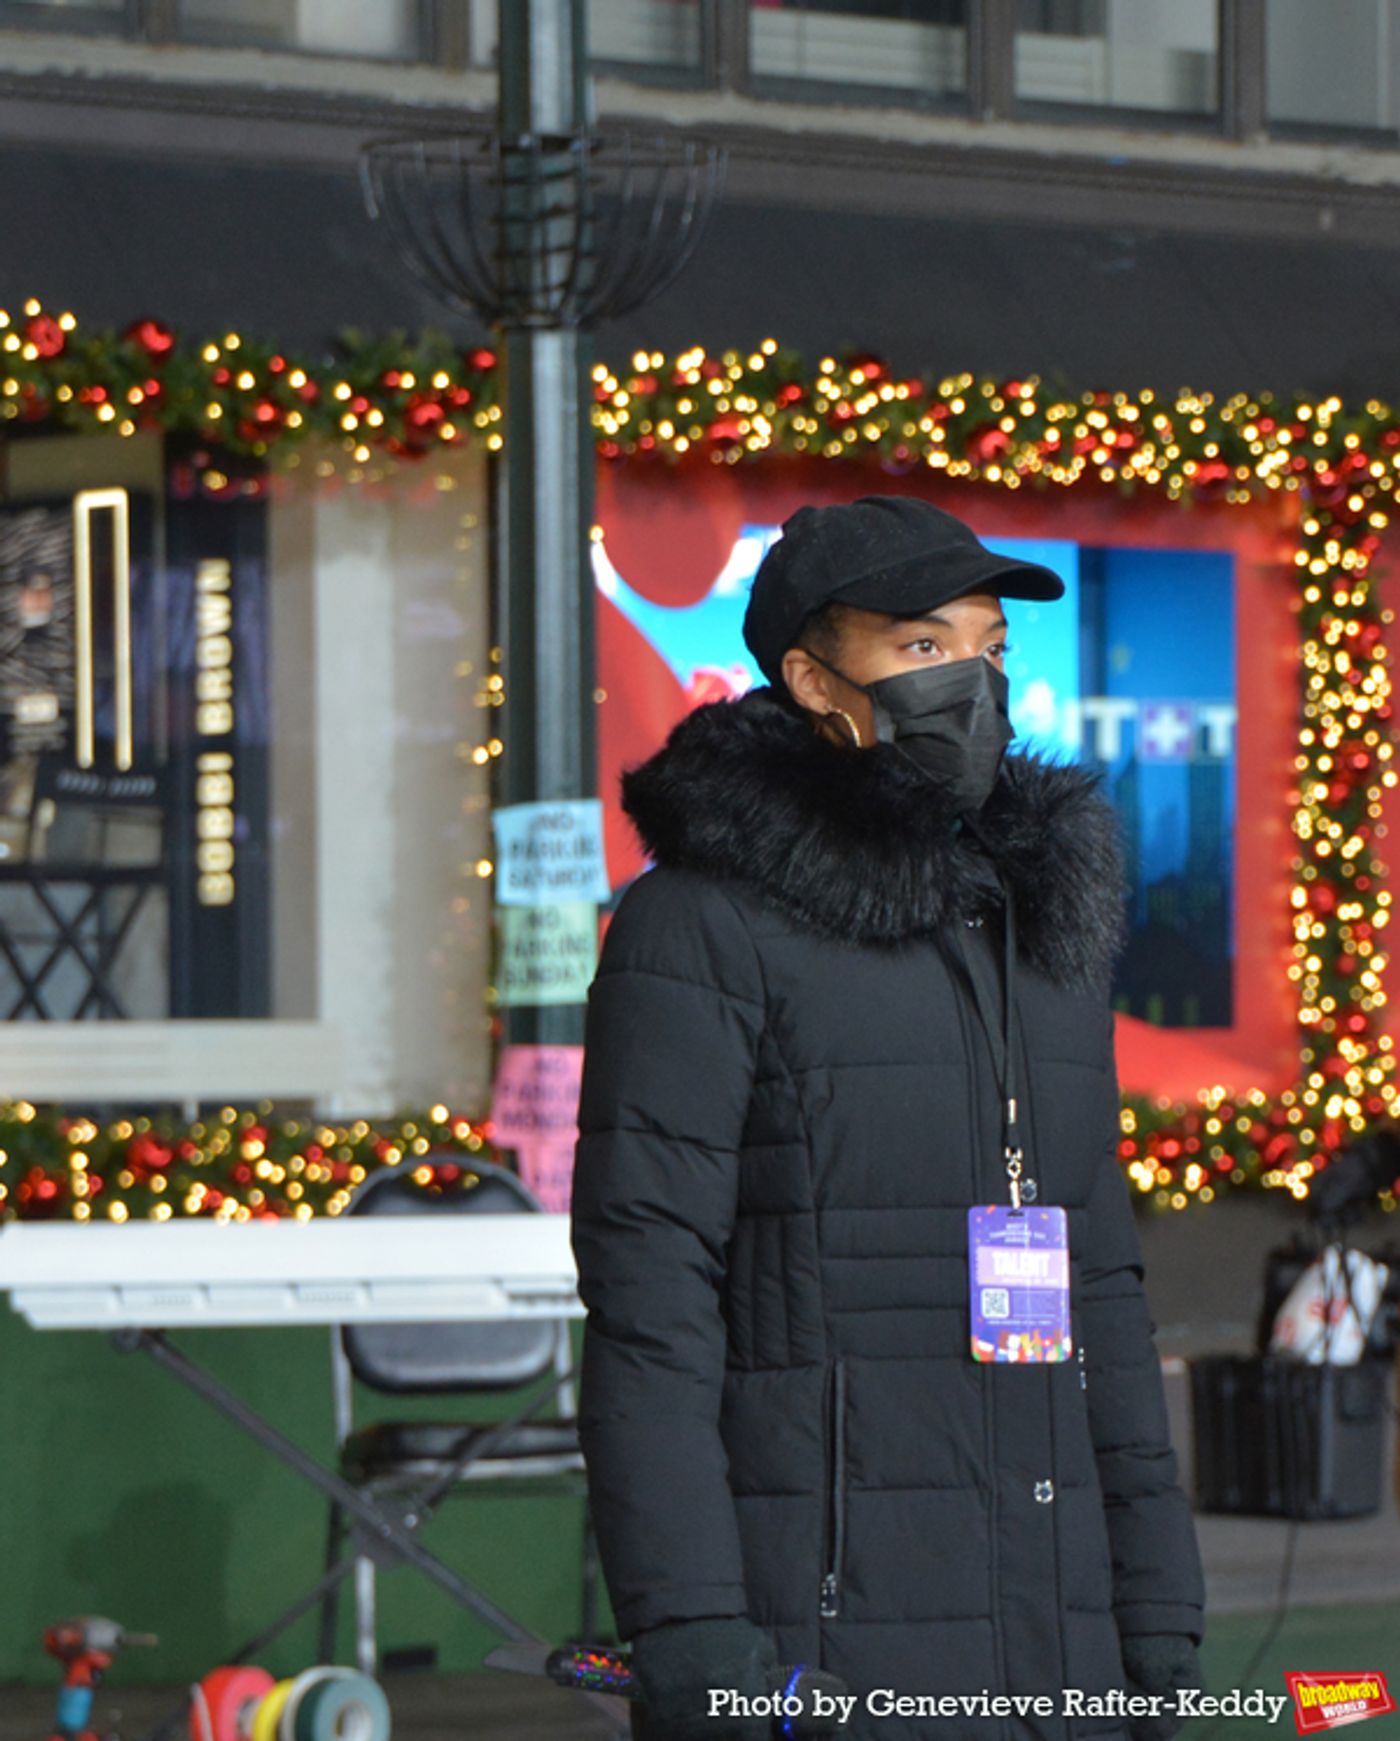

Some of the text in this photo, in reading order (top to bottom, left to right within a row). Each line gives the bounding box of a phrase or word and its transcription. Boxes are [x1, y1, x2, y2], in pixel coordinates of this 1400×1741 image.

[195, 558, 235, 906] BOBBI BROWN
[991, 1251, 1051, 1277] TALENT
